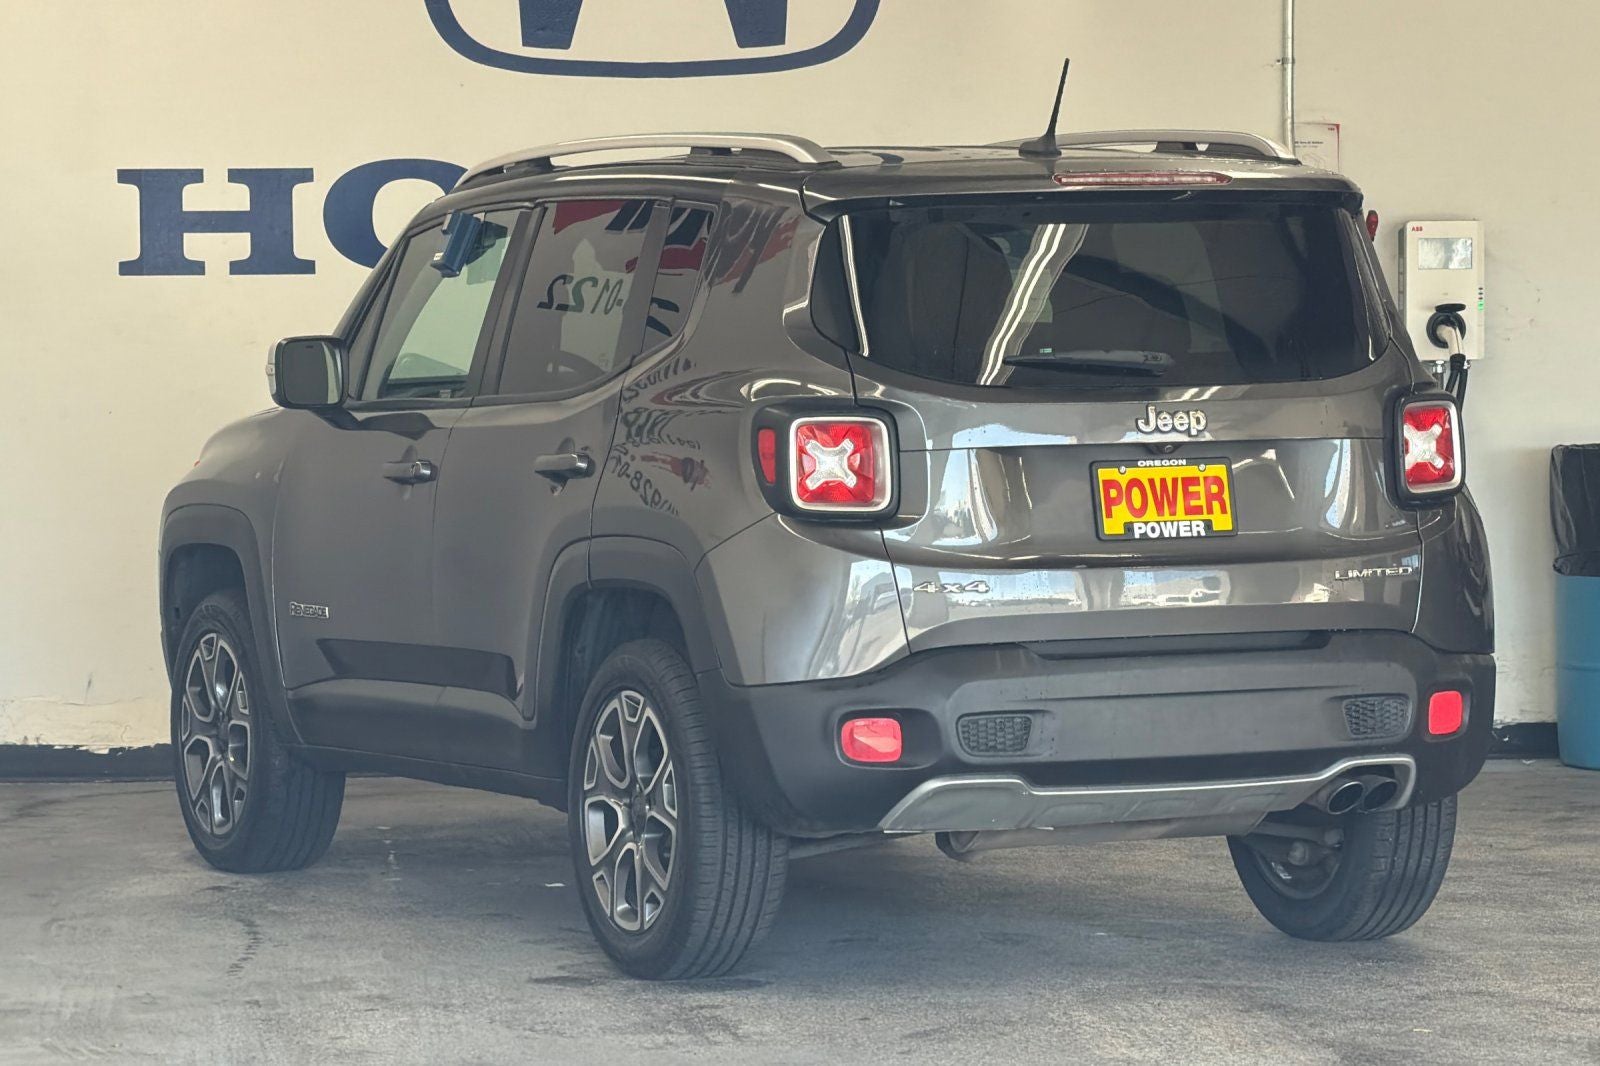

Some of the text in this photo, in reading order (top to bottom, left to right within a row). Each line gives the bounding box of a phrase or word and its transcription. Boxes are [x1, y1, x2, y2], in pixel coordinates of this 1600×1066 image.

[1136, 404, 1208, 437] Jeep
[1137, 459, 1187, 467] OREGON
[1101, 475, 1228, 519] POWER
[1133, 520, 1206, 539] POWER
[1335, 566, 1412, 580] LIMITED
[913, 580, 990, 593] 4x4
[290, 601, 330, 619] RENEGADE
